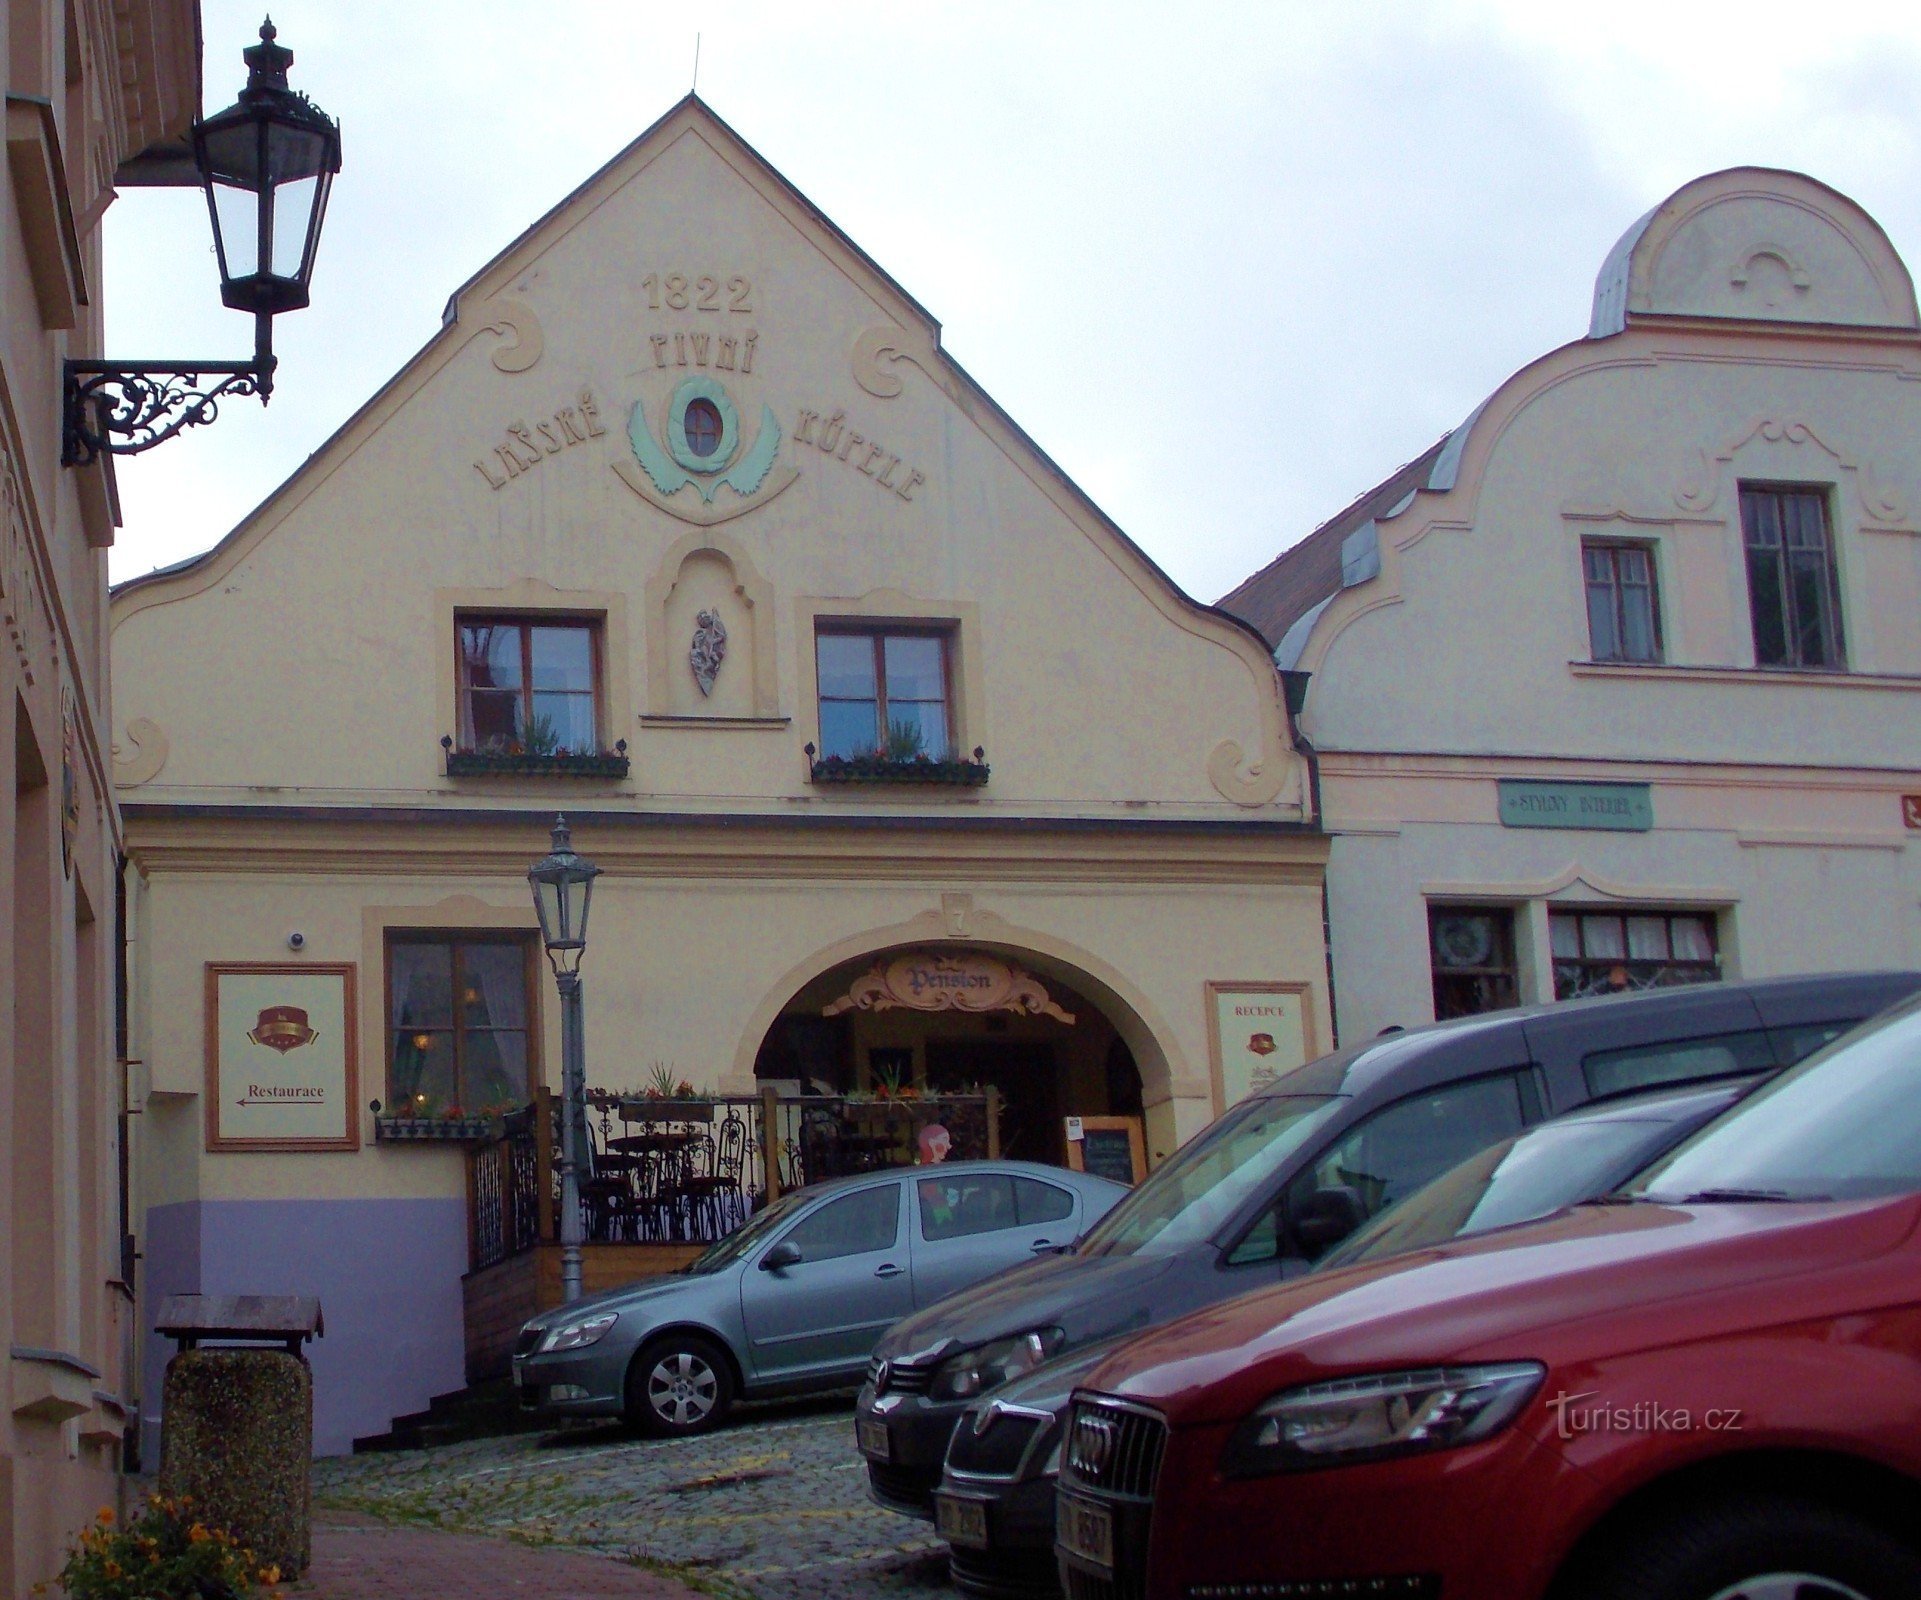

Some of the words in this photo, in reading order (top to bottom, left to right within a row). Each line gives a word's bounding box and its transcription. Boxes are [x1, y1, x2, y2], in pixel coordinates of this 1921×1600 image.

[641, 272, 752, 313] 1822
[472, 389, 606, 491] LAŠSKÉ
[649, 328, 760, 373] PIVNÍ
[793, 408, 926, 502] KÚPELE
[905, 967, 991, 996] Pension
[1235, 1006, 1285, 1017] RECEPCE
[249, 1084, 324, 1097] Restaurace
